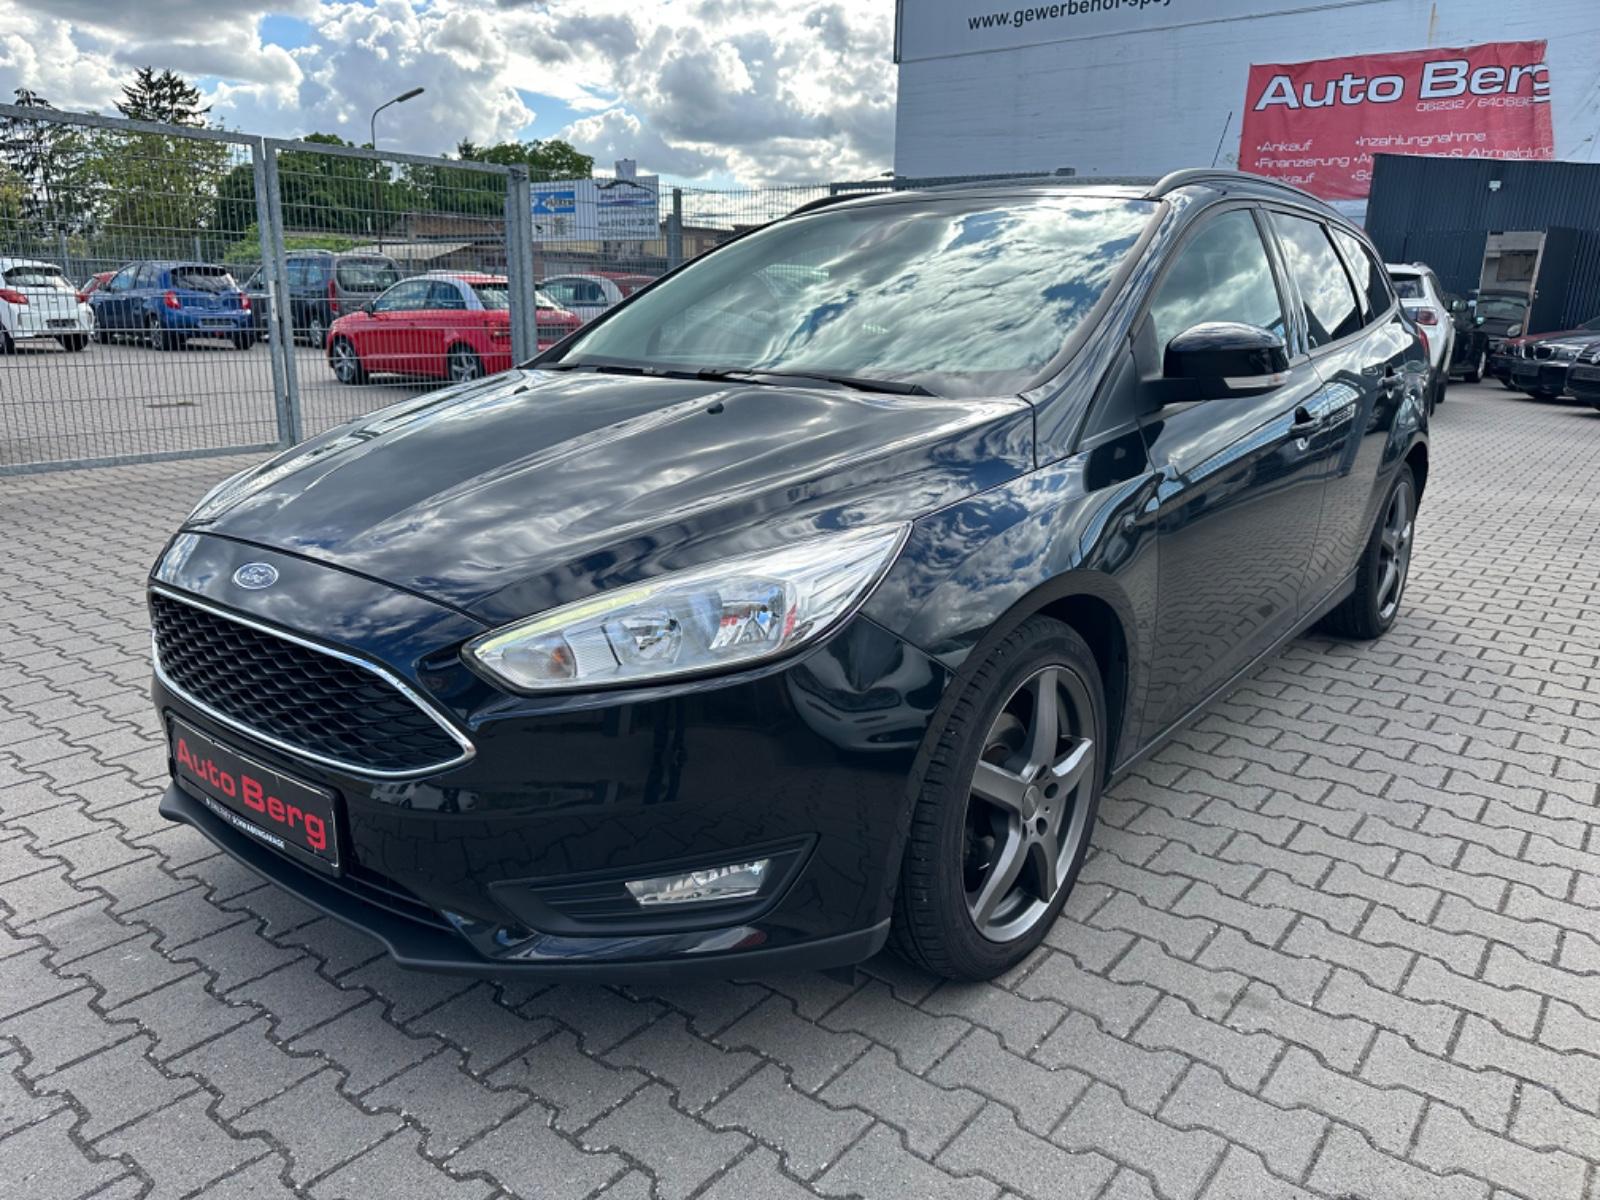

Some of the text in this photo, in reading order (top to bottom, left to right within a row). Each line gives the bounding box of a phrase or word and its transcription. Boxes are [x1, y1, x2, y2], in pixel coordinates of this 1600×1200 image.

[1253, 73, 1405, 112] Auto
[1261, 139, 1313, 152] Ankauf
[1359, 131, 1487, 147] Inzahlungnahme
[1259, 155, 1350, 168] Finanzierung
[176, 738, 327, 850] Auto Berg
